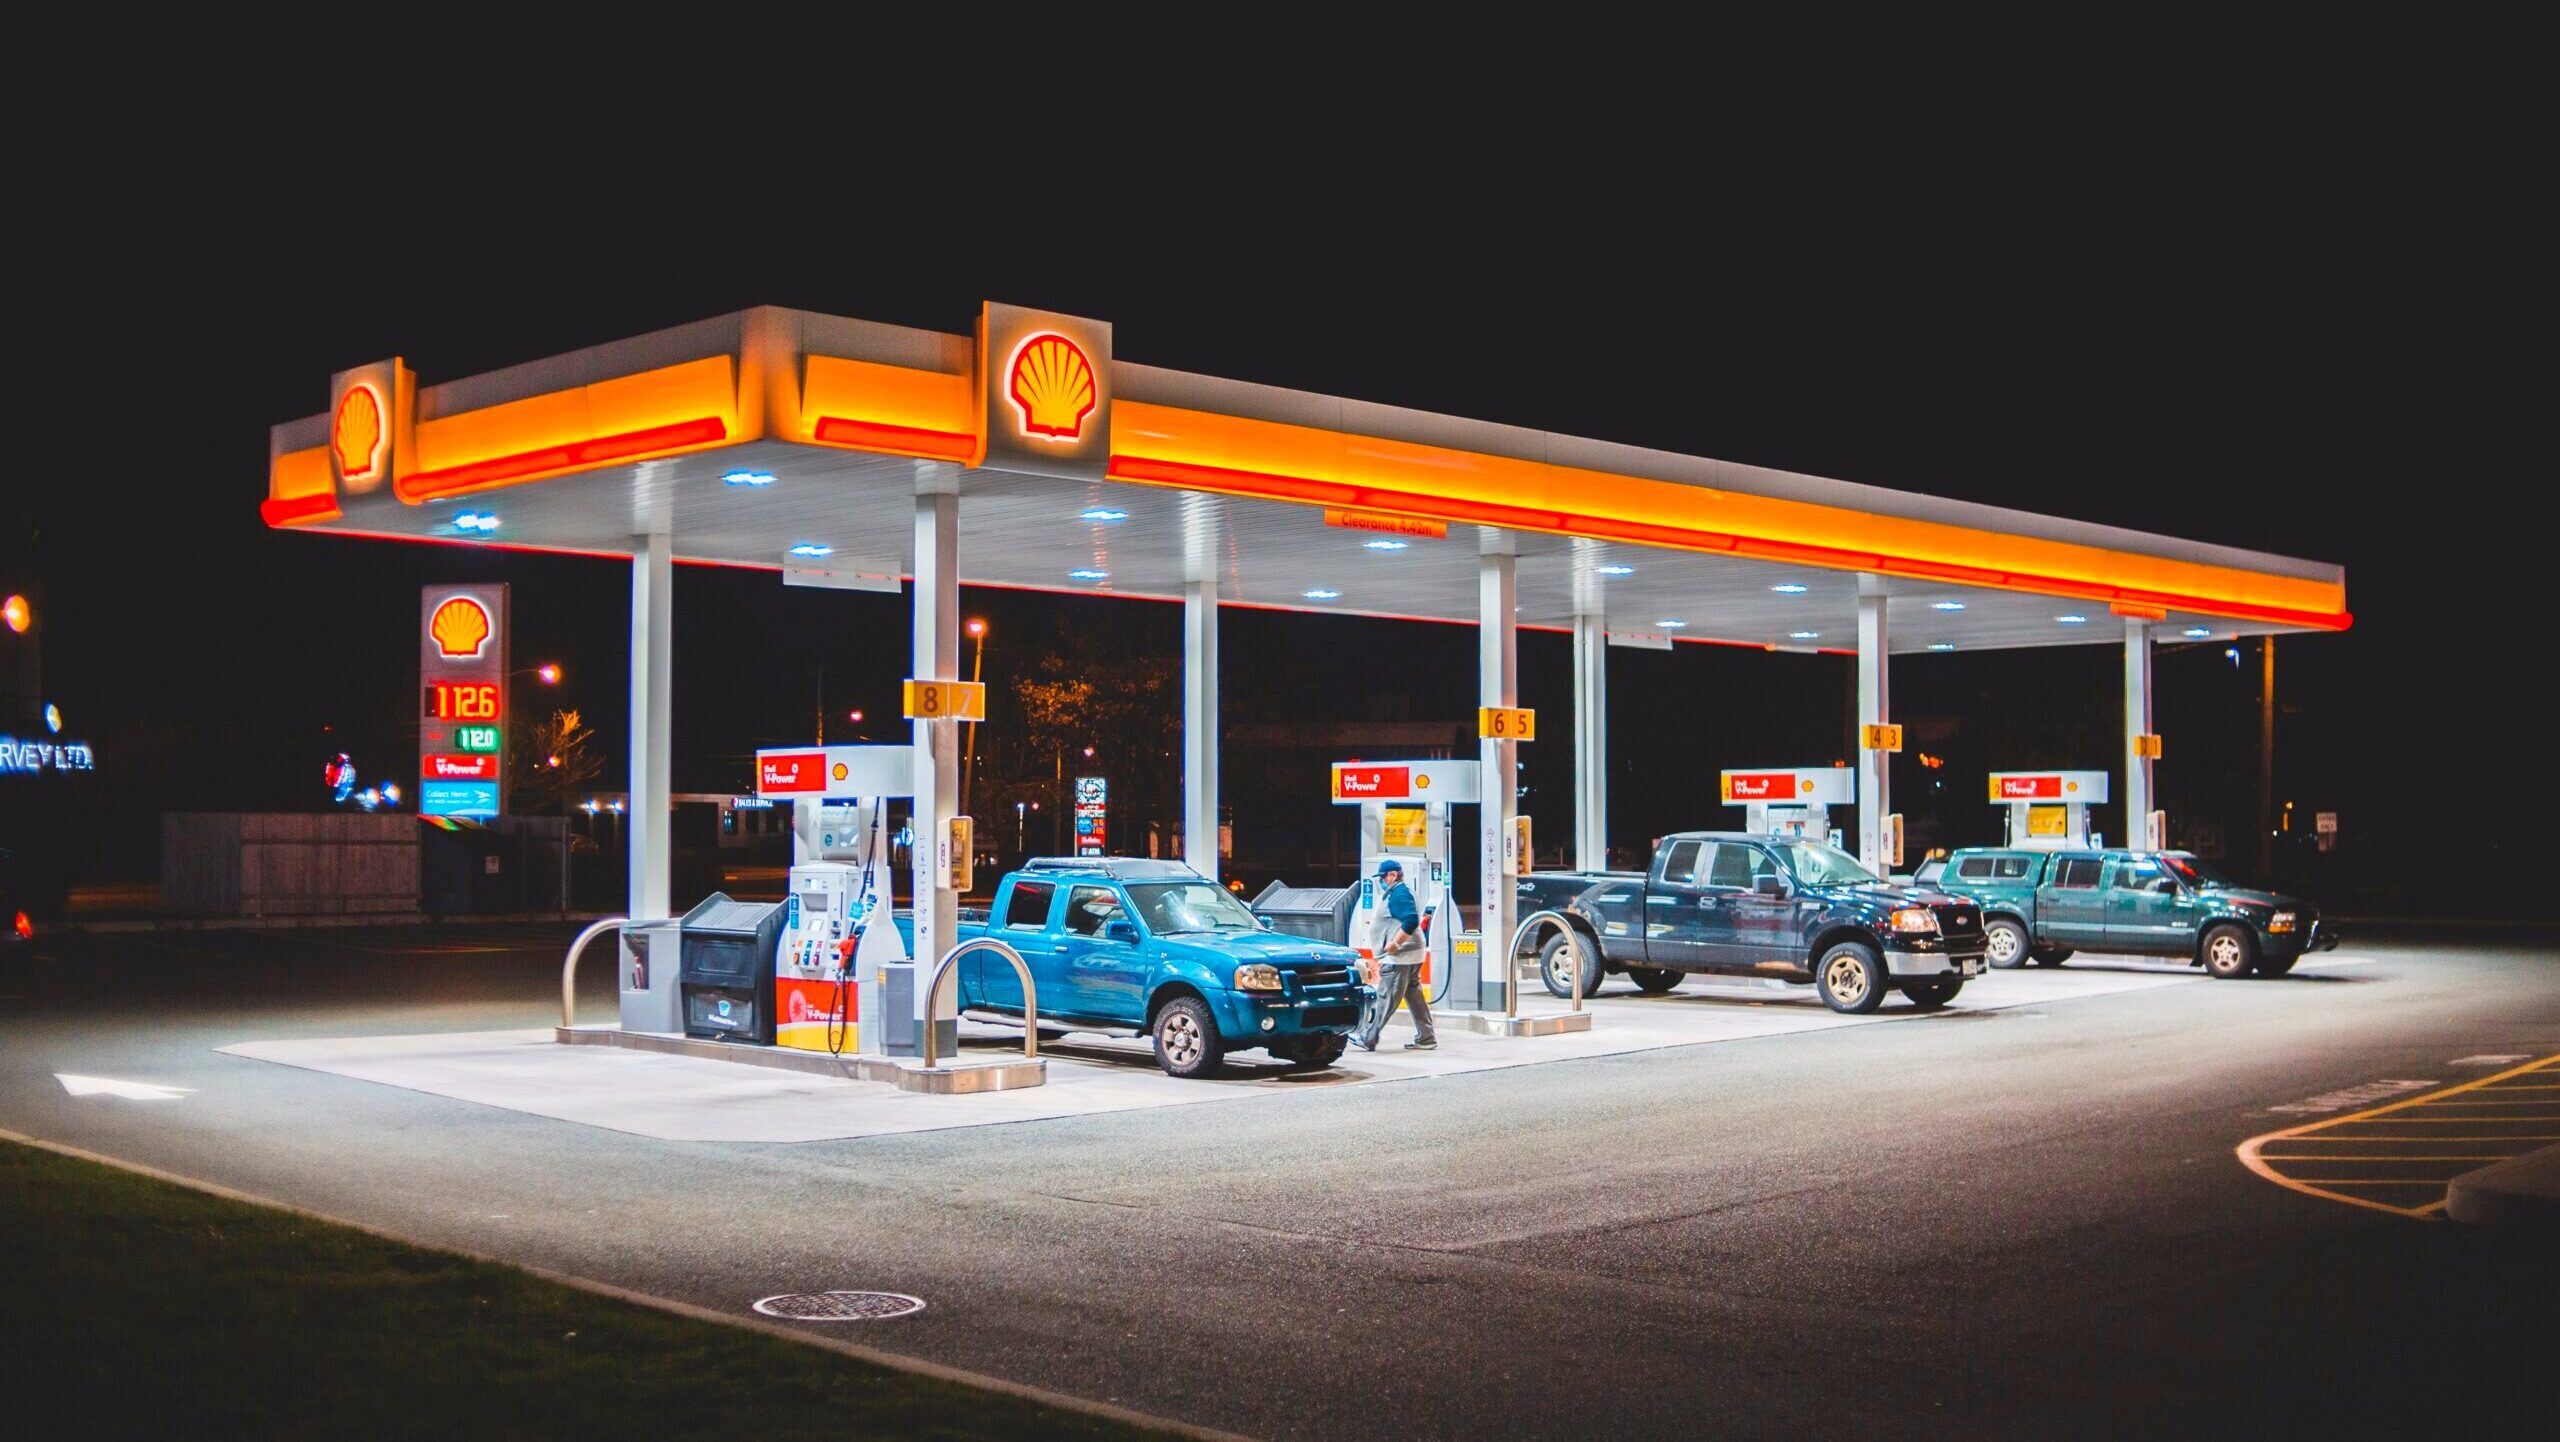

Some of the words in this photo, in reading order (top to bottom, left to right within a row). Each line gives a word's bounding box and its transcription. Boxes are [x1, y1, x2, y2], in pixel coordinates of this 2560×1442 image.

[1341, 512, 1396, 532] Clearance
[924, 686, 938, 713] 8
[960, 688, 974, 714] 7
[1494, 712, 1504, 734] 6
[1518, 713, 1527, 734] 5
[1873, 729, 1881, 747] 4
[1890, 729, 1897, 747] 3
[436, 763, 483, 774] V-Power
[764, 772, 797, 784] V-Power
[1344, 781, 1378, 791] V-Power
